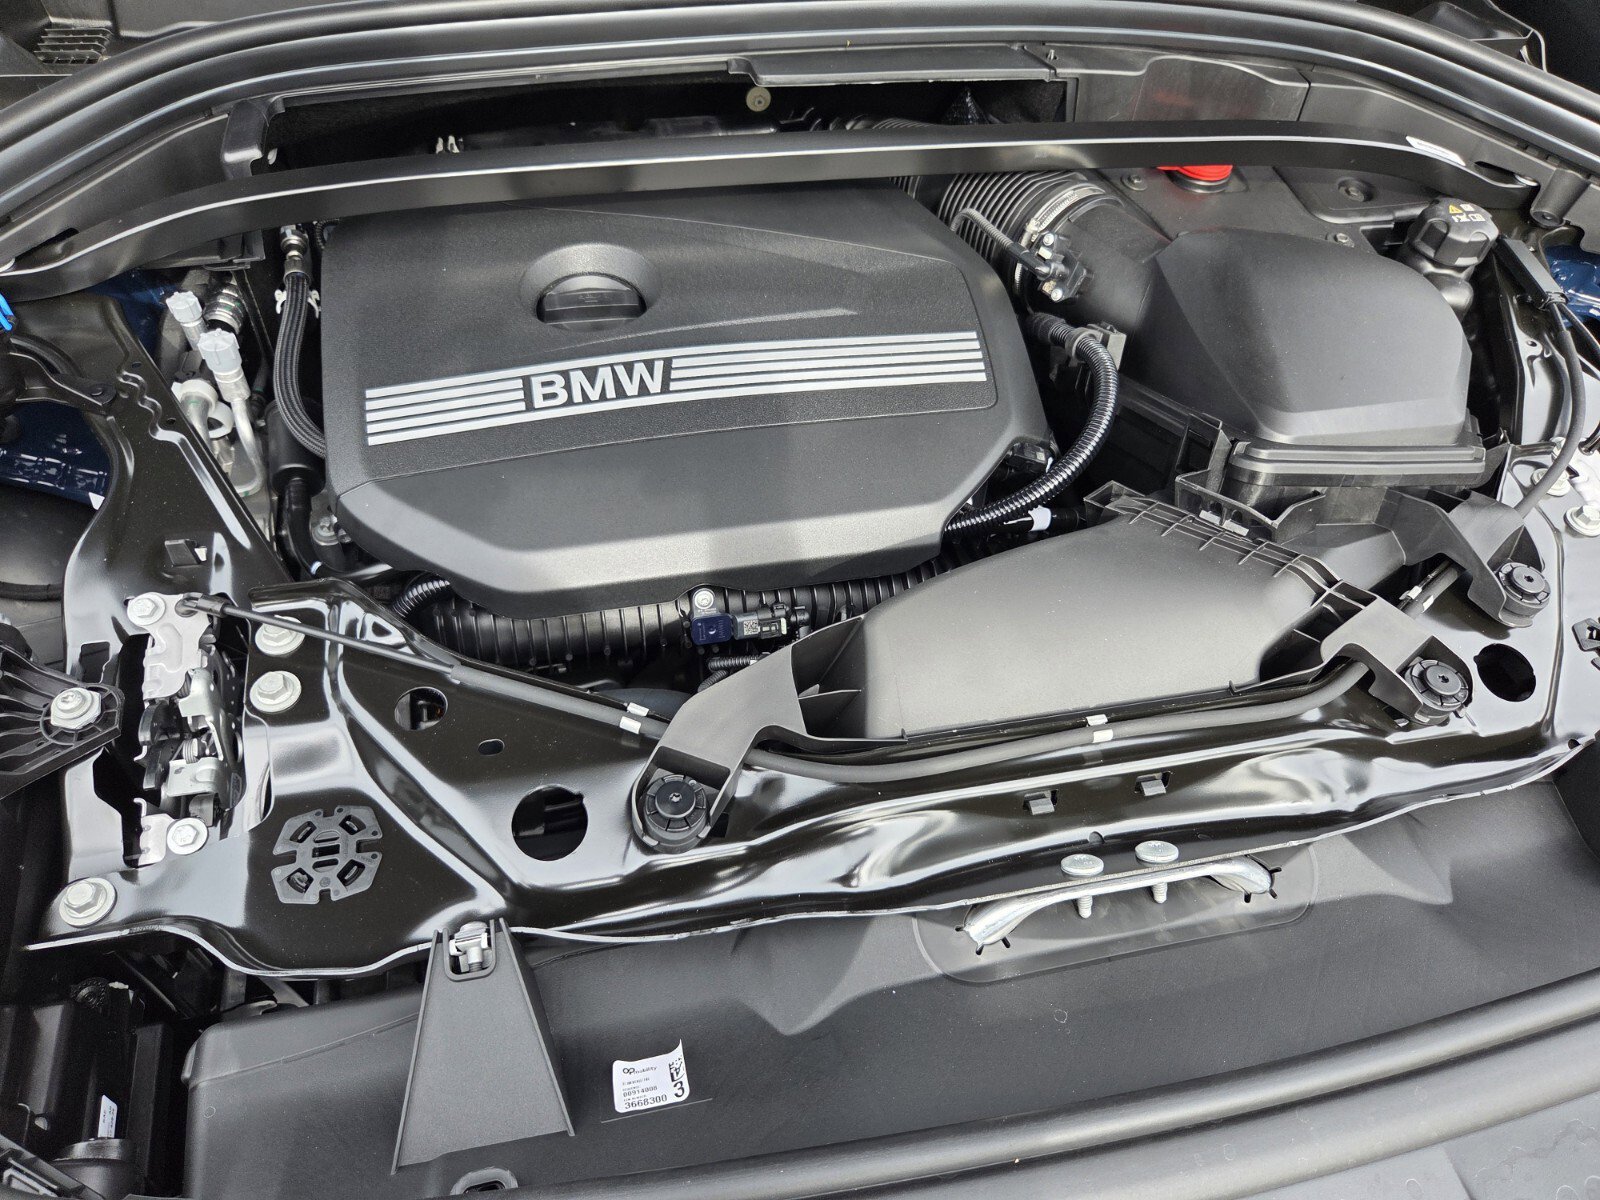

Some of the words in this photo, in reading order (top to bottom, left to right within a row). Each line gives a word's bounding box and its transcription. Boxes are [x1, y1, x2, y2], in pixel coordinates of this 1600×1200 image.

[530, 359, 664, 409] BMW
[673, 1080, 685, 1098] 3
[624, 1095, 668, 1109] 3668300
